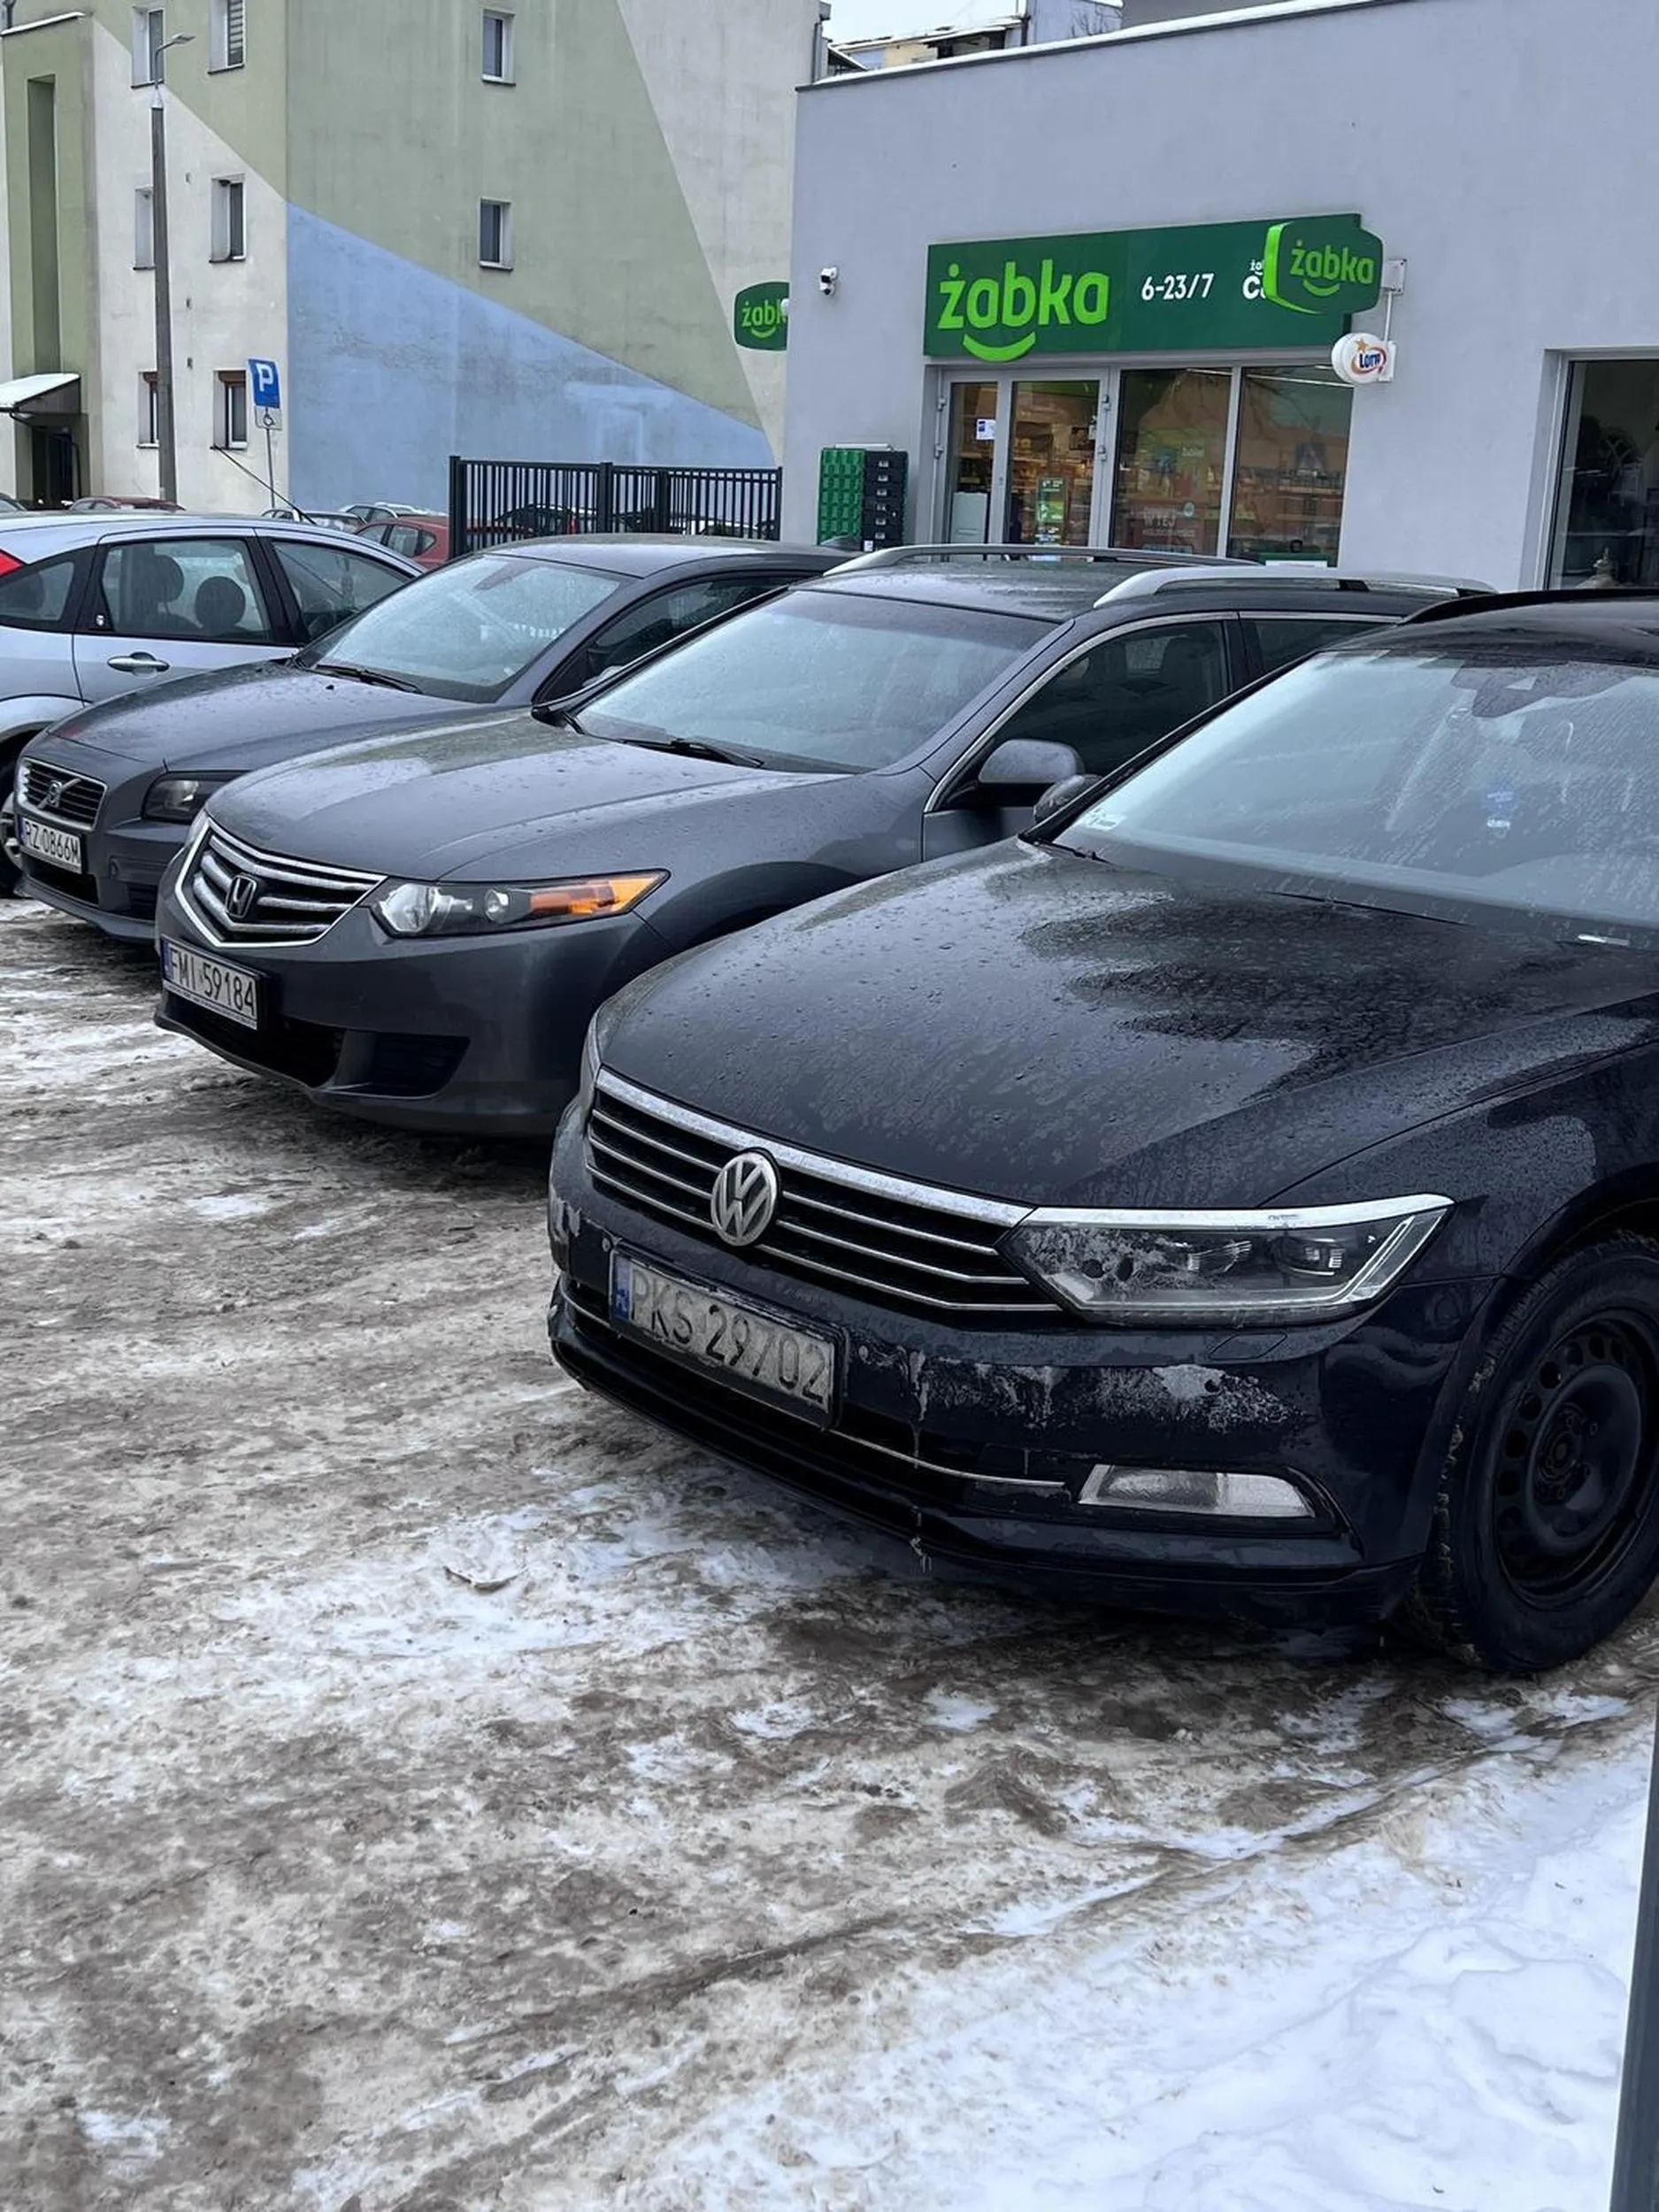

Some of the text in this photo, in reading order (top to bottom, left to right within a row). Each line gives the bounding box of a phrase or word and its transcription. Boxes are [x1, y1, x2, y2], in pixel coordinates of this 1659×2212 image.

[1289, 239, 1374, 284] żabka
[937, 258, 1110, 329] żabka
[1141, 273, 1214, 301] 6-23/7
[255, 363, 273, 392] P
[170, 946, 196, 991] FMI
[202, 961, 256, 1018] 59184
